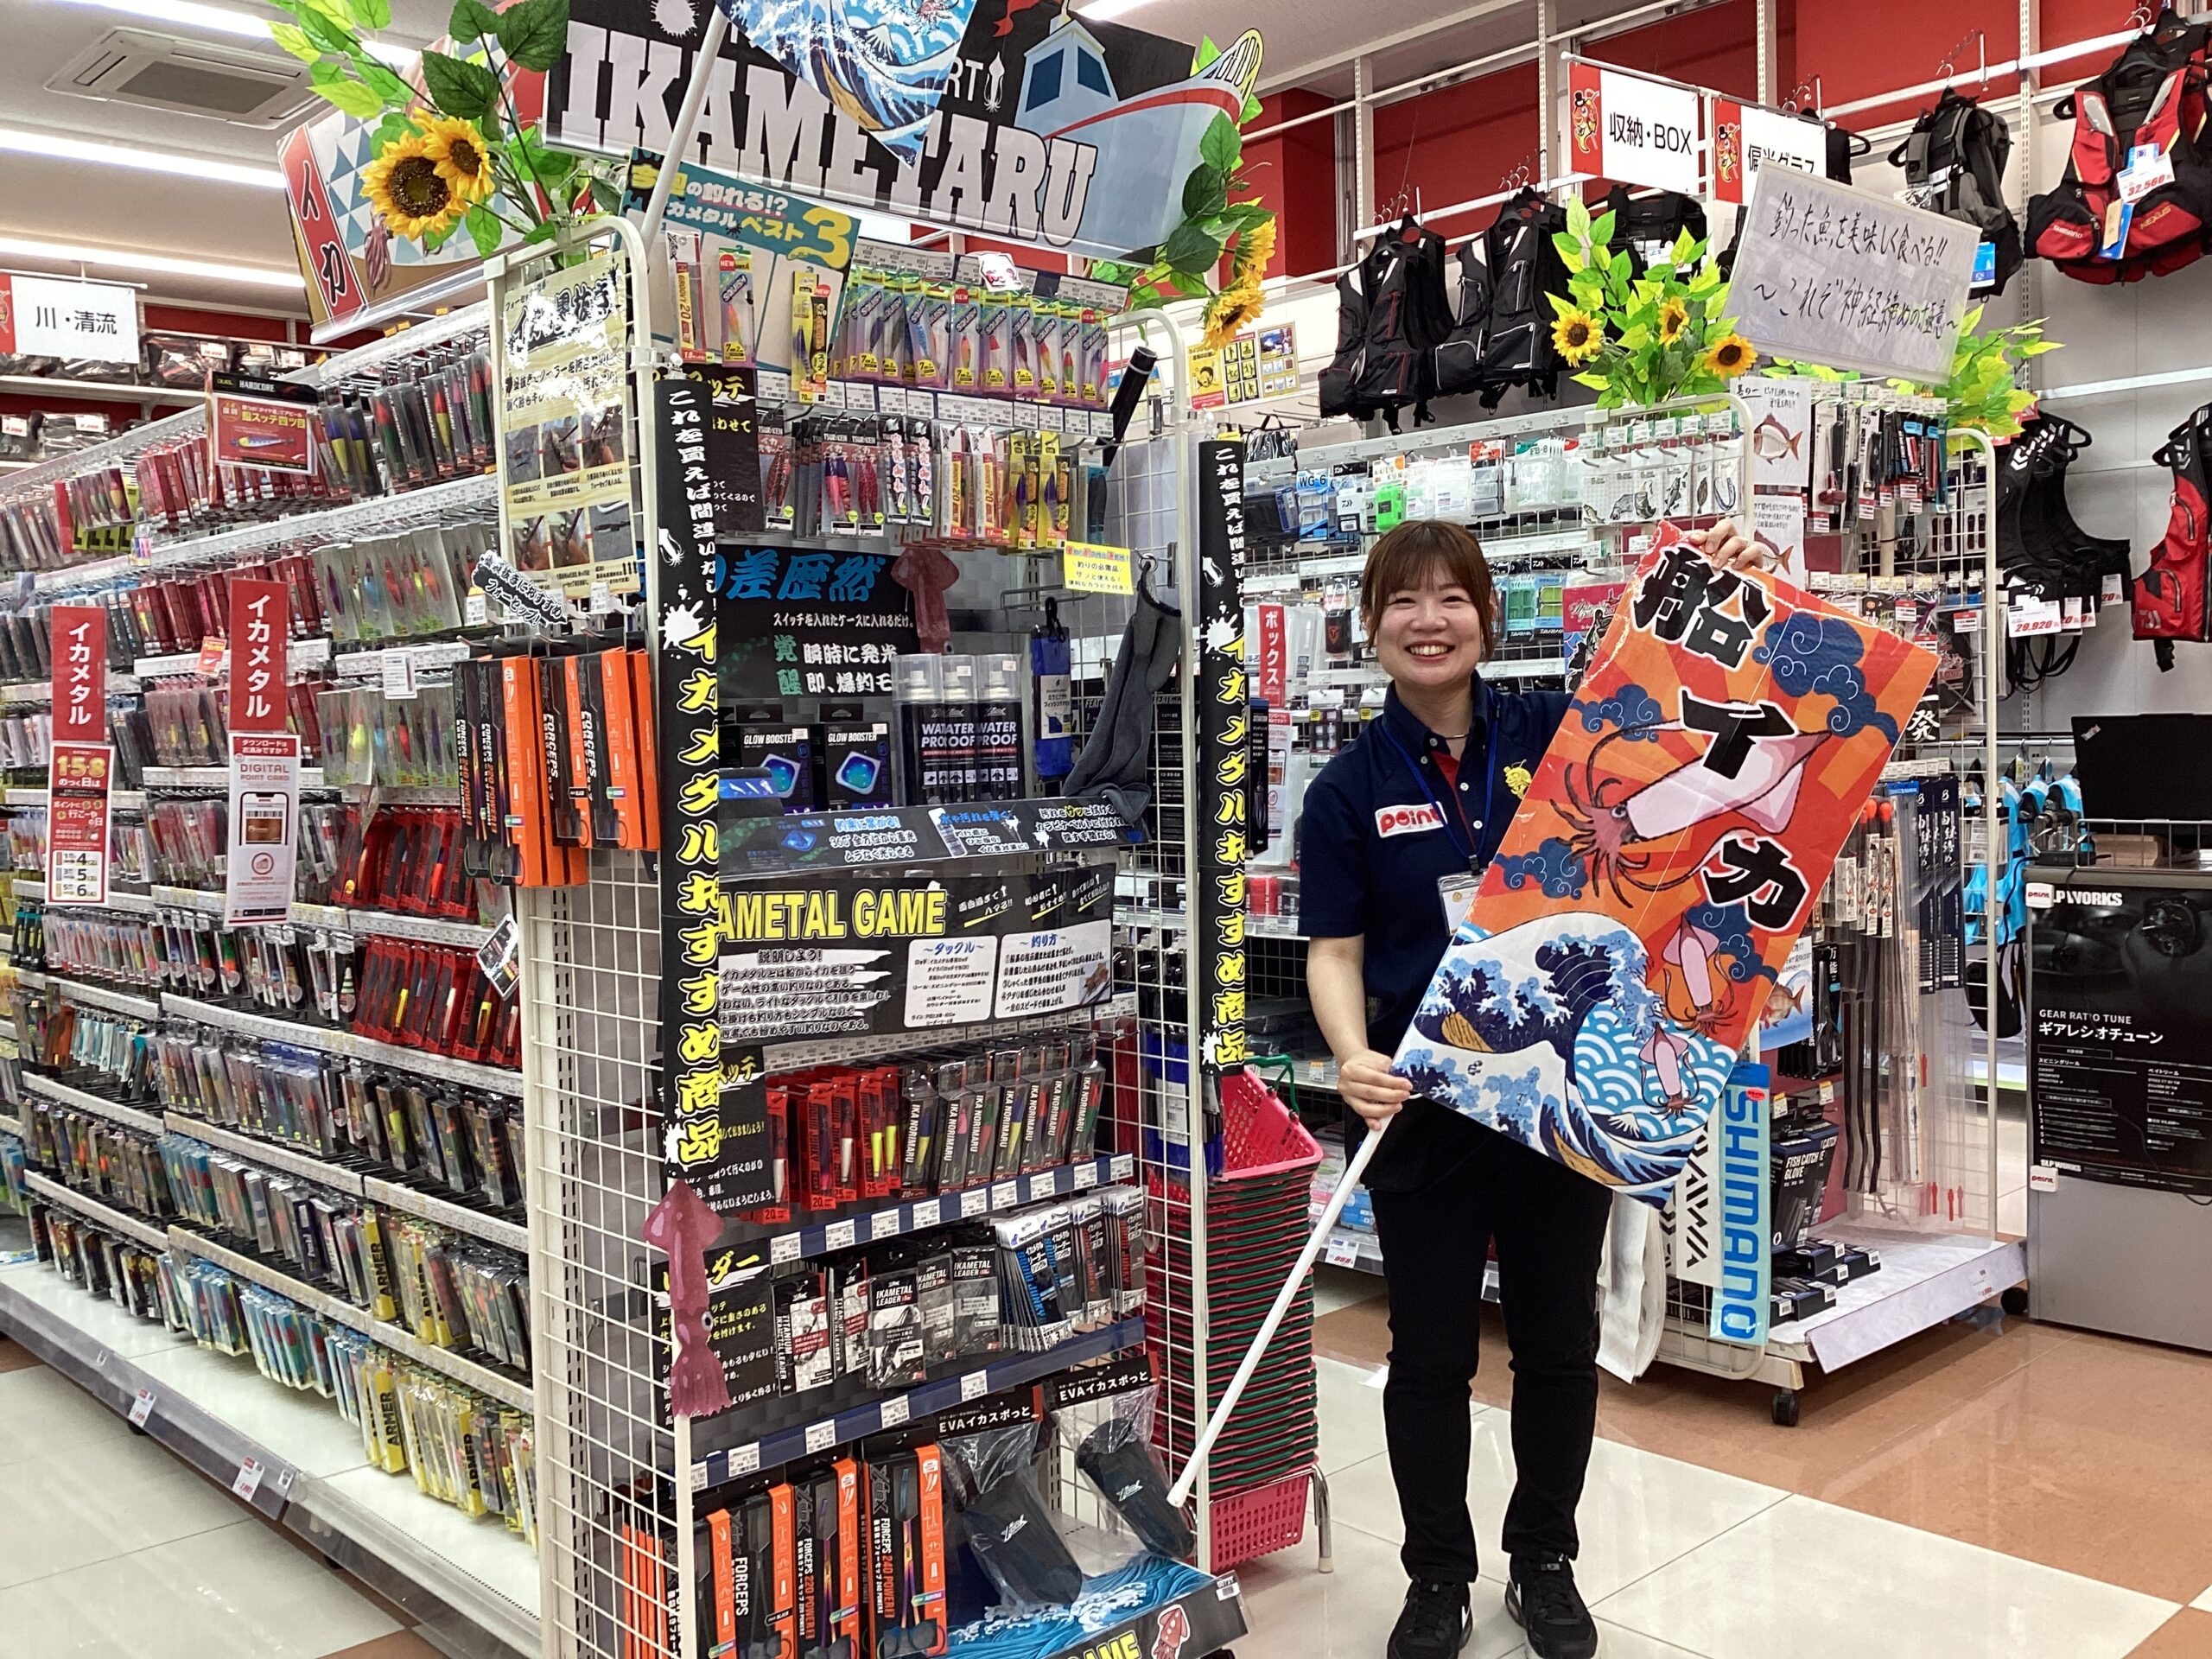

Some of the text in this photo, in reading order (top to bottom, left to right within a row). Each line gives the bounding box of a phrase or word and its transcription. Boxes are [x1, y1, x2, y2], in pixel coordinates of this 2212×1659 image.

[561, 21, 1098, 247] IKAMETARU
[1610, 111, 1692, 156] 収納・BOX
[665, 200, 804, 243] カメタルベスト
[2053, 225, 2083, 238] SHIMANO
[2140, 207, 2171, 230] NEXUS
[35, 303, 118, 335] 川・清流
[239, 380, 276, 392] HARDCORE
[1529, 445, 1548, 456] FB-8
[1300, 475, 1326, 487] WG-6
[2015, 620, 2052, 632] 29,920
[246, 594, 272, 718] イカメタル
[1265, 610, 1279, 684] ボックス
[67, 622, 92, 726] イカメタル
[805, 671, 893, 694] 即、爆釣モ
[744, 734, 765, 745] GLOW
[828, 731, 877, 743] GLOW BOOSTER
[944, 722, 975, 734] ATER
[547, 714, 559, 778] FORCEPS
[585, 711, 597, 778] FORCEPS
[240, 764, 289, 773] DIGITAL
[2027, 889, 2050, 899] point
[852, 888, 949, 938] GAME
[2039, 1009, 2132, 1025] GEAR RATO TUNE
[2038, 1058, 2081, 1067] スピニングリール
[999, 1090, 1014, 1148] IKA NORIMARU
[1025, 1084, 1039, 1141] IKA NORIMARU
[1047, 1080, 1062, 1137] IKA NORIMARU
[1076, 1090, 1089, 1133] NORIMARU
[718, 1121, 765, 1140] しておきましょう!
[906, 1104, 921, 1164] IKA NORIMARU
[944, 1103, 959, 1162] IKA NORIMARU
[969, 1095, 984, 1153] IKA NORIMARU
[1784, 1166, 1803, 1179] GLOVE
[1786, 1153, 1819, 1168] FISH CATCH
[1721, 1090, 1759, 1339] SHIMANO
[918, 1268, 947, 1284] KAMETAL
[954, 1260, 992, 1270] IKAMETAL
[954, 1268, 979, 1278] LEADER
[876, 1286, 912, 1300] IKAMETAL
[876, 1296, 901, 1307] LEADER
[782, 1315, 792, 1355] TITANIUM
[1059, 1371, 1149, 1402] EVAイカスポっと
[938, 1405, 1031, 1434] EVAイカスポっと
[880, 1517, 893, 1575] FORCEPS 240
[804, 1537, 814, 1595] FORCEPS 220
[735, 1557, 748, 1616] FORCEPS
